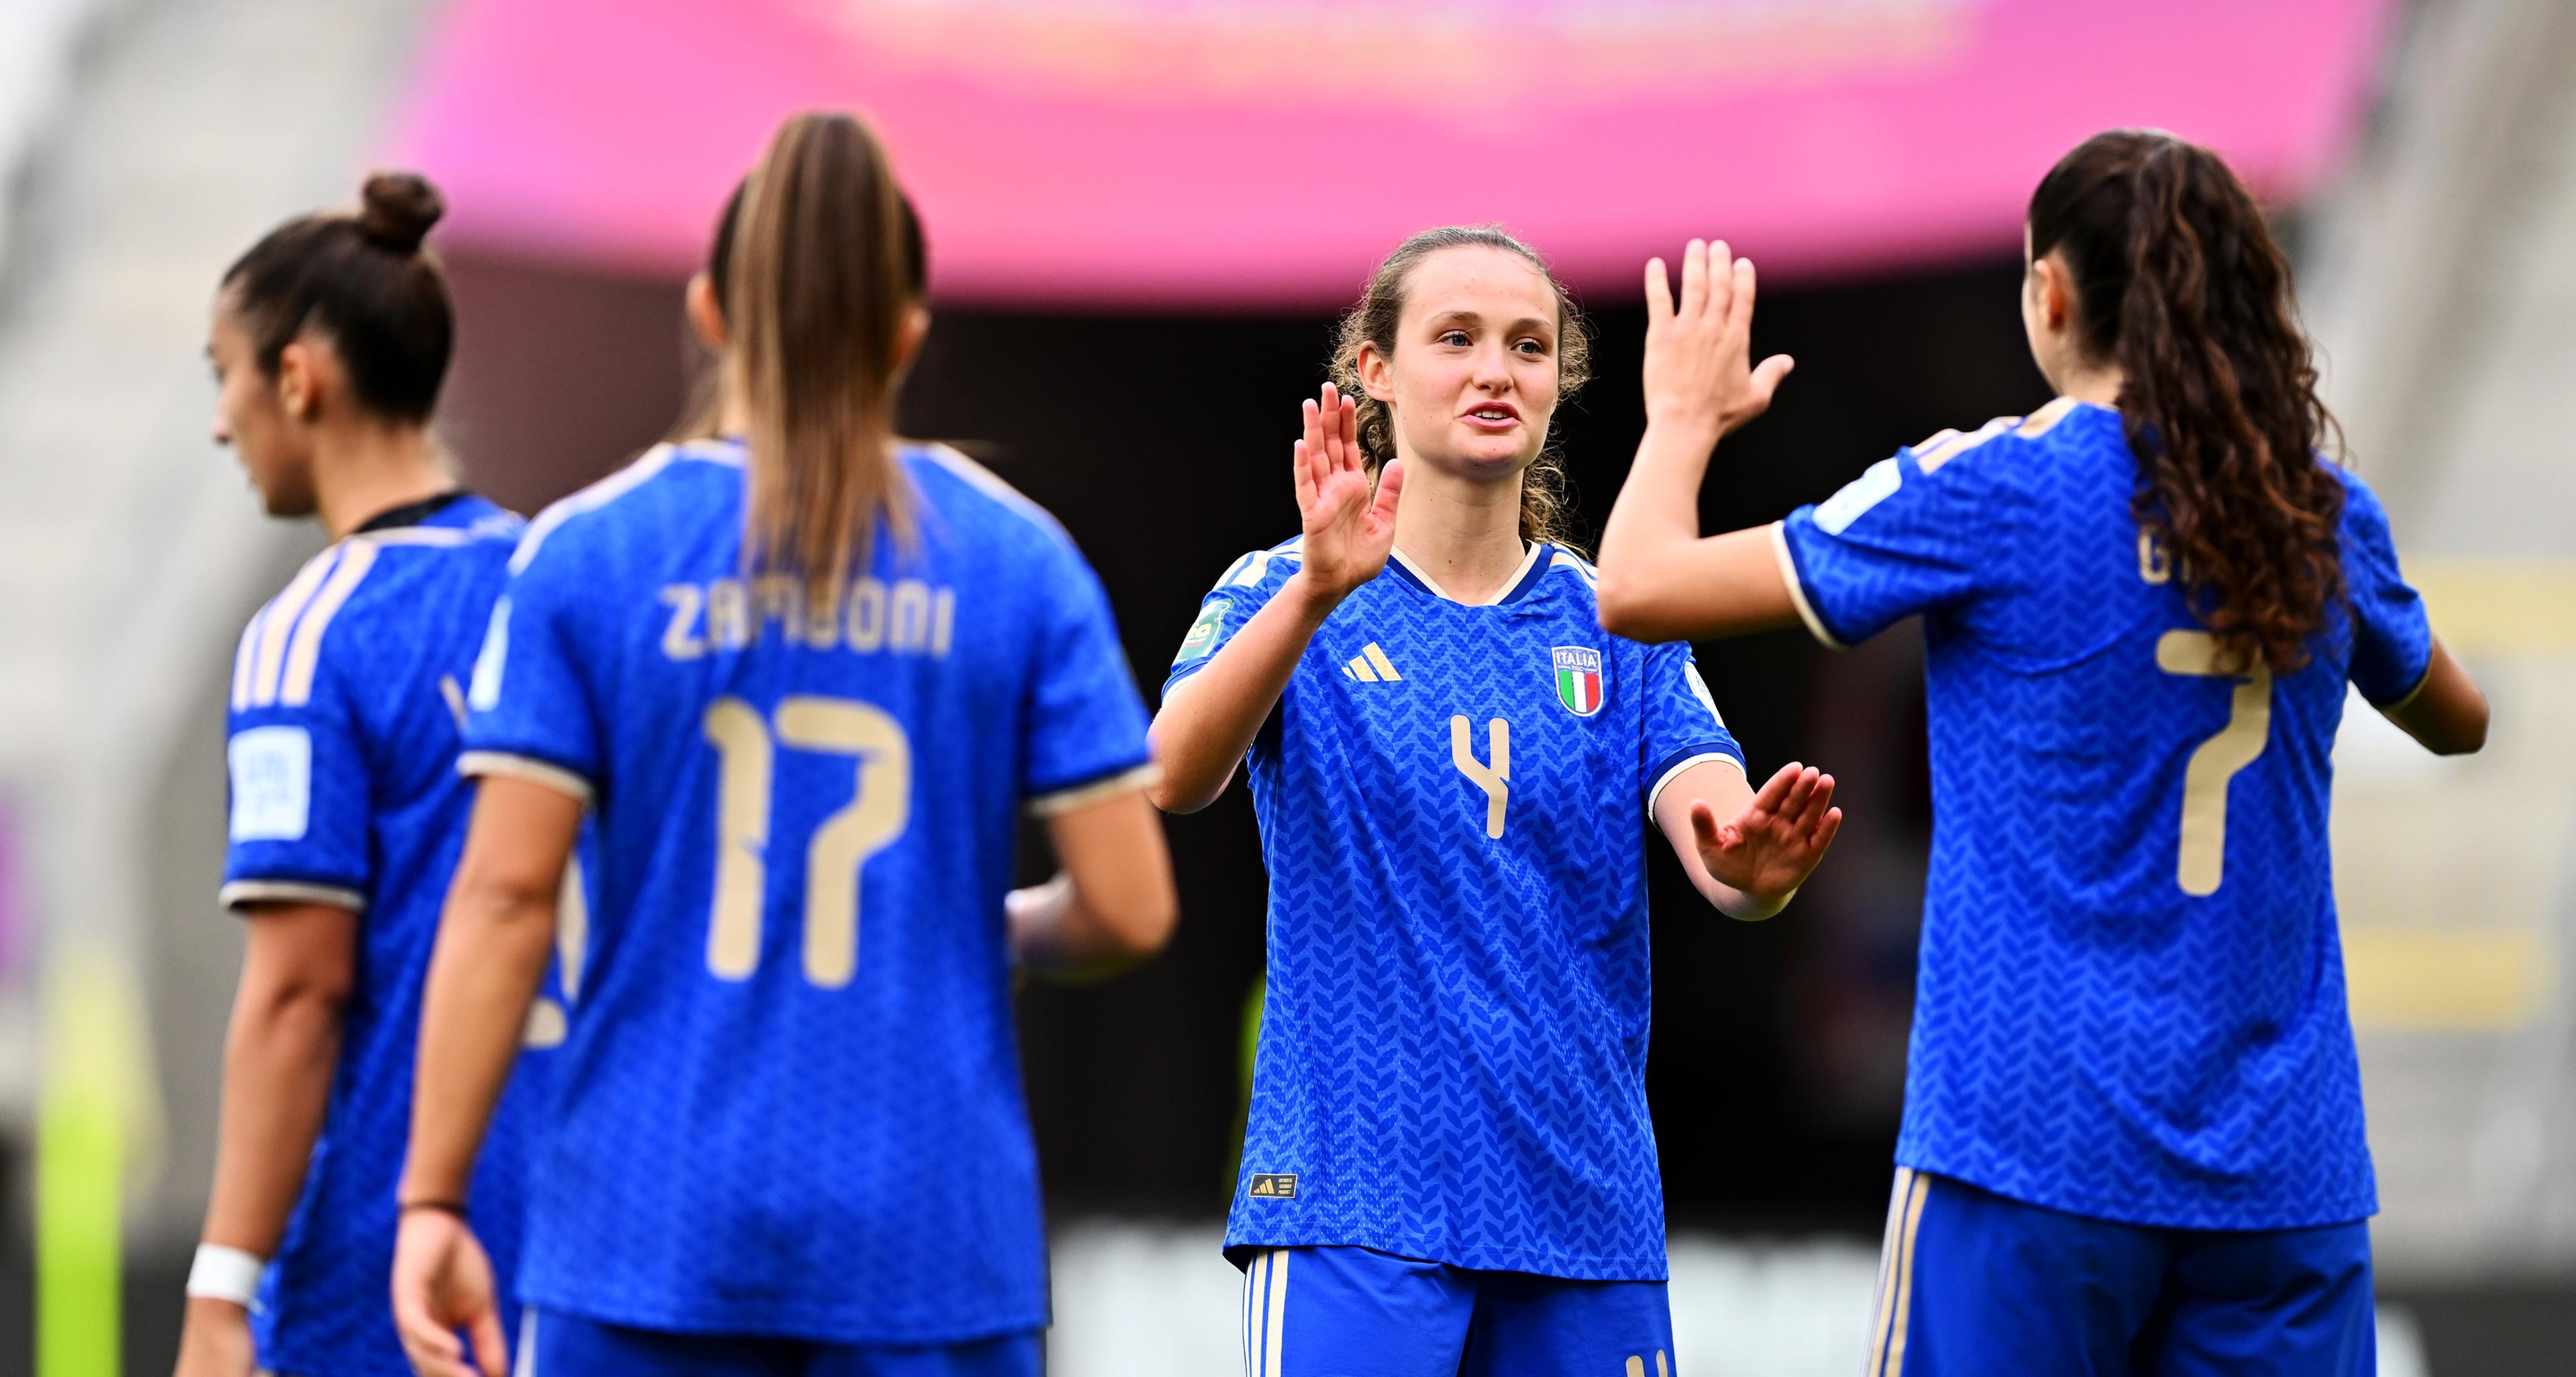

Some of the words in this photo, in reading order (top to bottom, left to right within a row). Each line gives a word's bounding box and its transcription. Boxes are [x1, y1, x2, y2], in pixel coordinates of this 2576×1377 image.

[1556, 651, 1597, 667] ITALIA
[704, 695, 912, 989] 17
[1450, 714, 1509, 839] 4
[2156, 629, 2272, 896] 7
